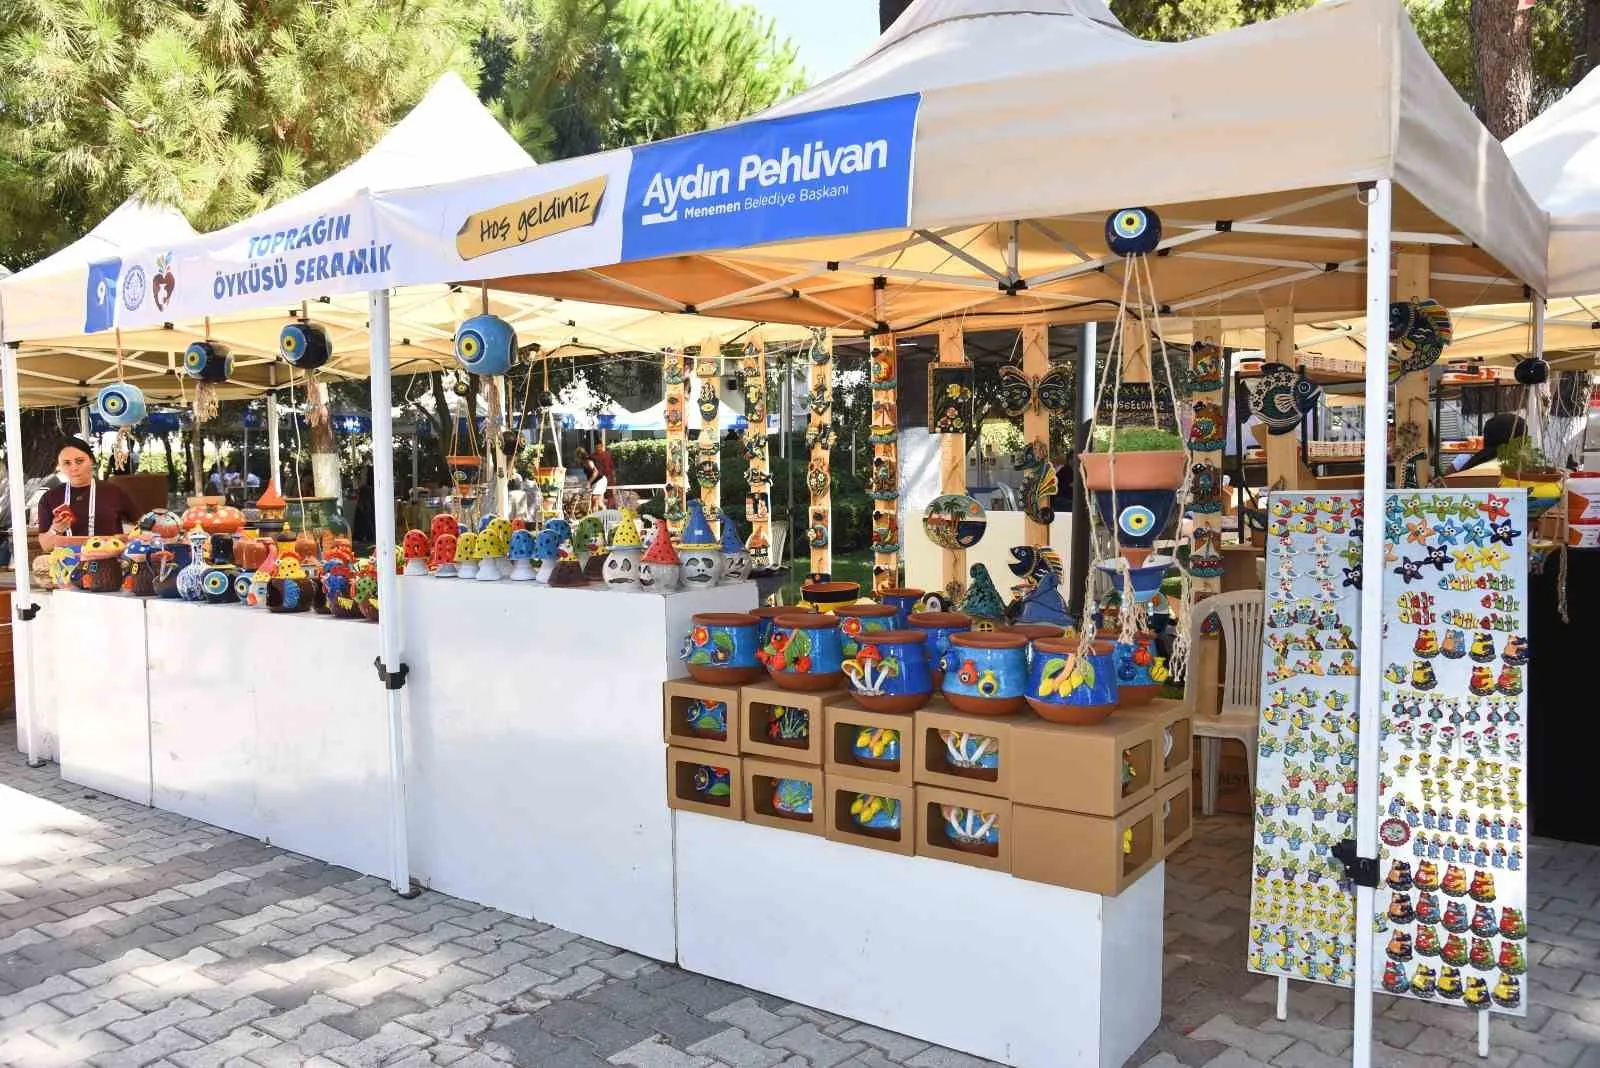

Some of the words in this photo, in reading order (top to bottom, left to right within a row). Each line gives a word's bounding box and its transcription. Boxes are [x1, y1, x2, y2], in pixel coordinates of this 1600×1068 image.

[642, 163, 730, 214] Aydın
[738, 138, 888, 192] Pehlivan
[684, 201, 741, 220] Menemen
[744, 191, 796, 211] Belediye
[799, 183, 849, 204] Başkanı
[247, 213, 352, 259] TOPRAĞIN
[479, 216, 511, 242] Hoş
[517, 191, 591, 243] geldiniz
[213, 257, 288, 300] ÖYKÜSÜ
[294, 239, 393, 286] SERAMİK
